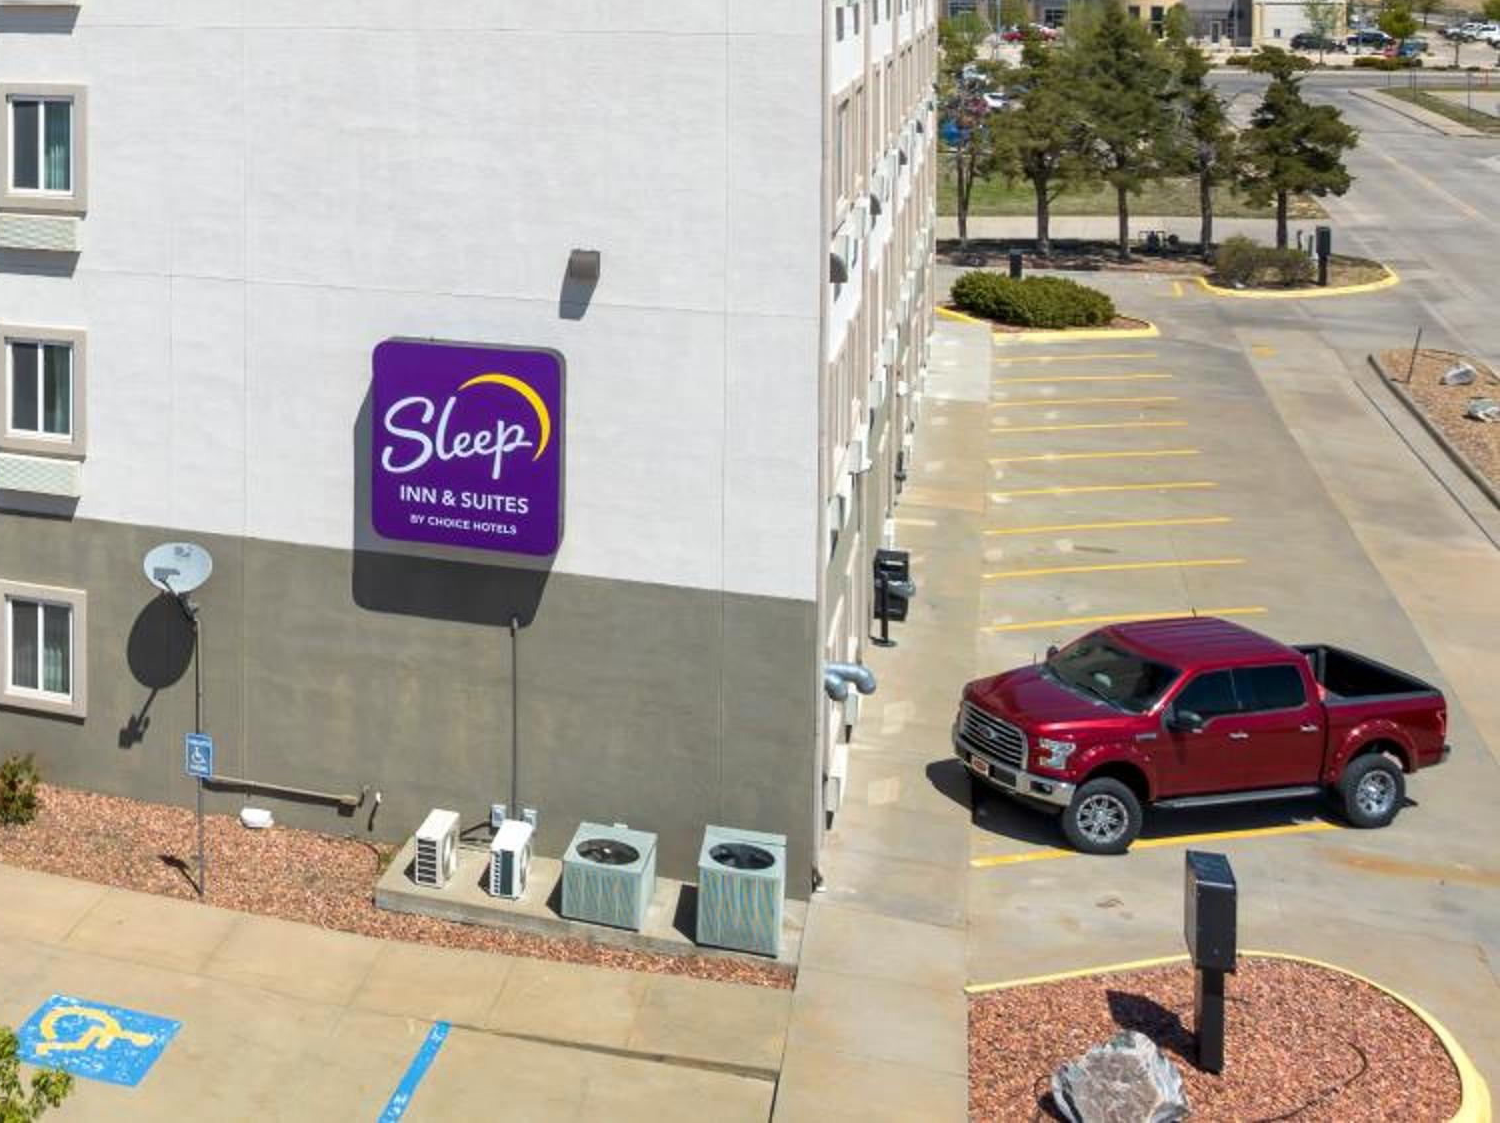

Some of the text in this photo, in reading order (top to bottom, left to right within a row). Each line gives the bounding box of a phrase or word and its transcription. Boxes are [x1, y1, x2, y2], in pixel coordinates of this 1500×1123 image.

[381, 396, 533, 480] Sleep
[400, 484, 529, 514] INN & SUITES
[410, 515, 517, 534] BY CHOICE HOTELS
